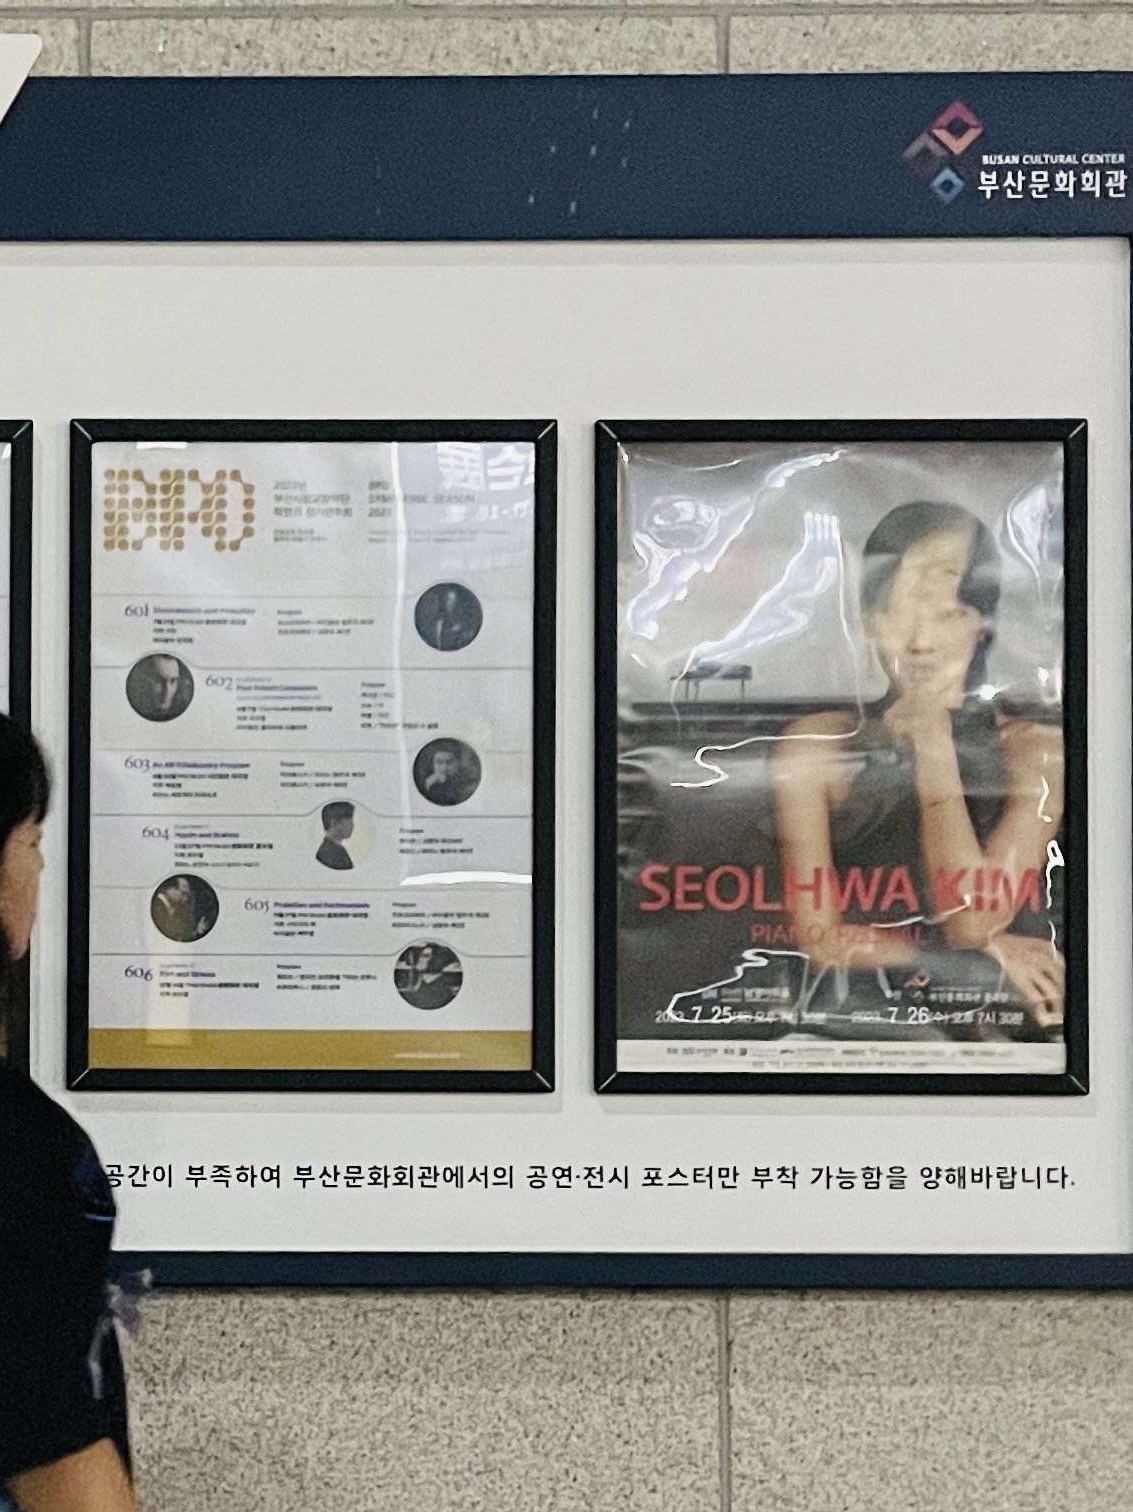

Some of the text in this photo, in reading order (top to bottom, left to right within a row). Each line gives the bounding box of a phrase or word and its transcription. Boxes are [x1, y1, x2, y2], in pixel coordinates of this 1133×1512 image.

[982, 153, 1126, 165] BUSAN CULTURAL CENTER
[978, 169, 1128, 199] 부산문화회관
[205, 673, 233, 691] 602
[124, 755, 150, 772] 603
[637, 865, 1045, 912] SEOLHWA KIM
[125, 965, 153, 982] 606
[105, 1164, 1076, 1189] 공간이 부족하여 부산문화회관에서의 공연·전시 포스터만 부착 가능함을 양해바랍니다.
